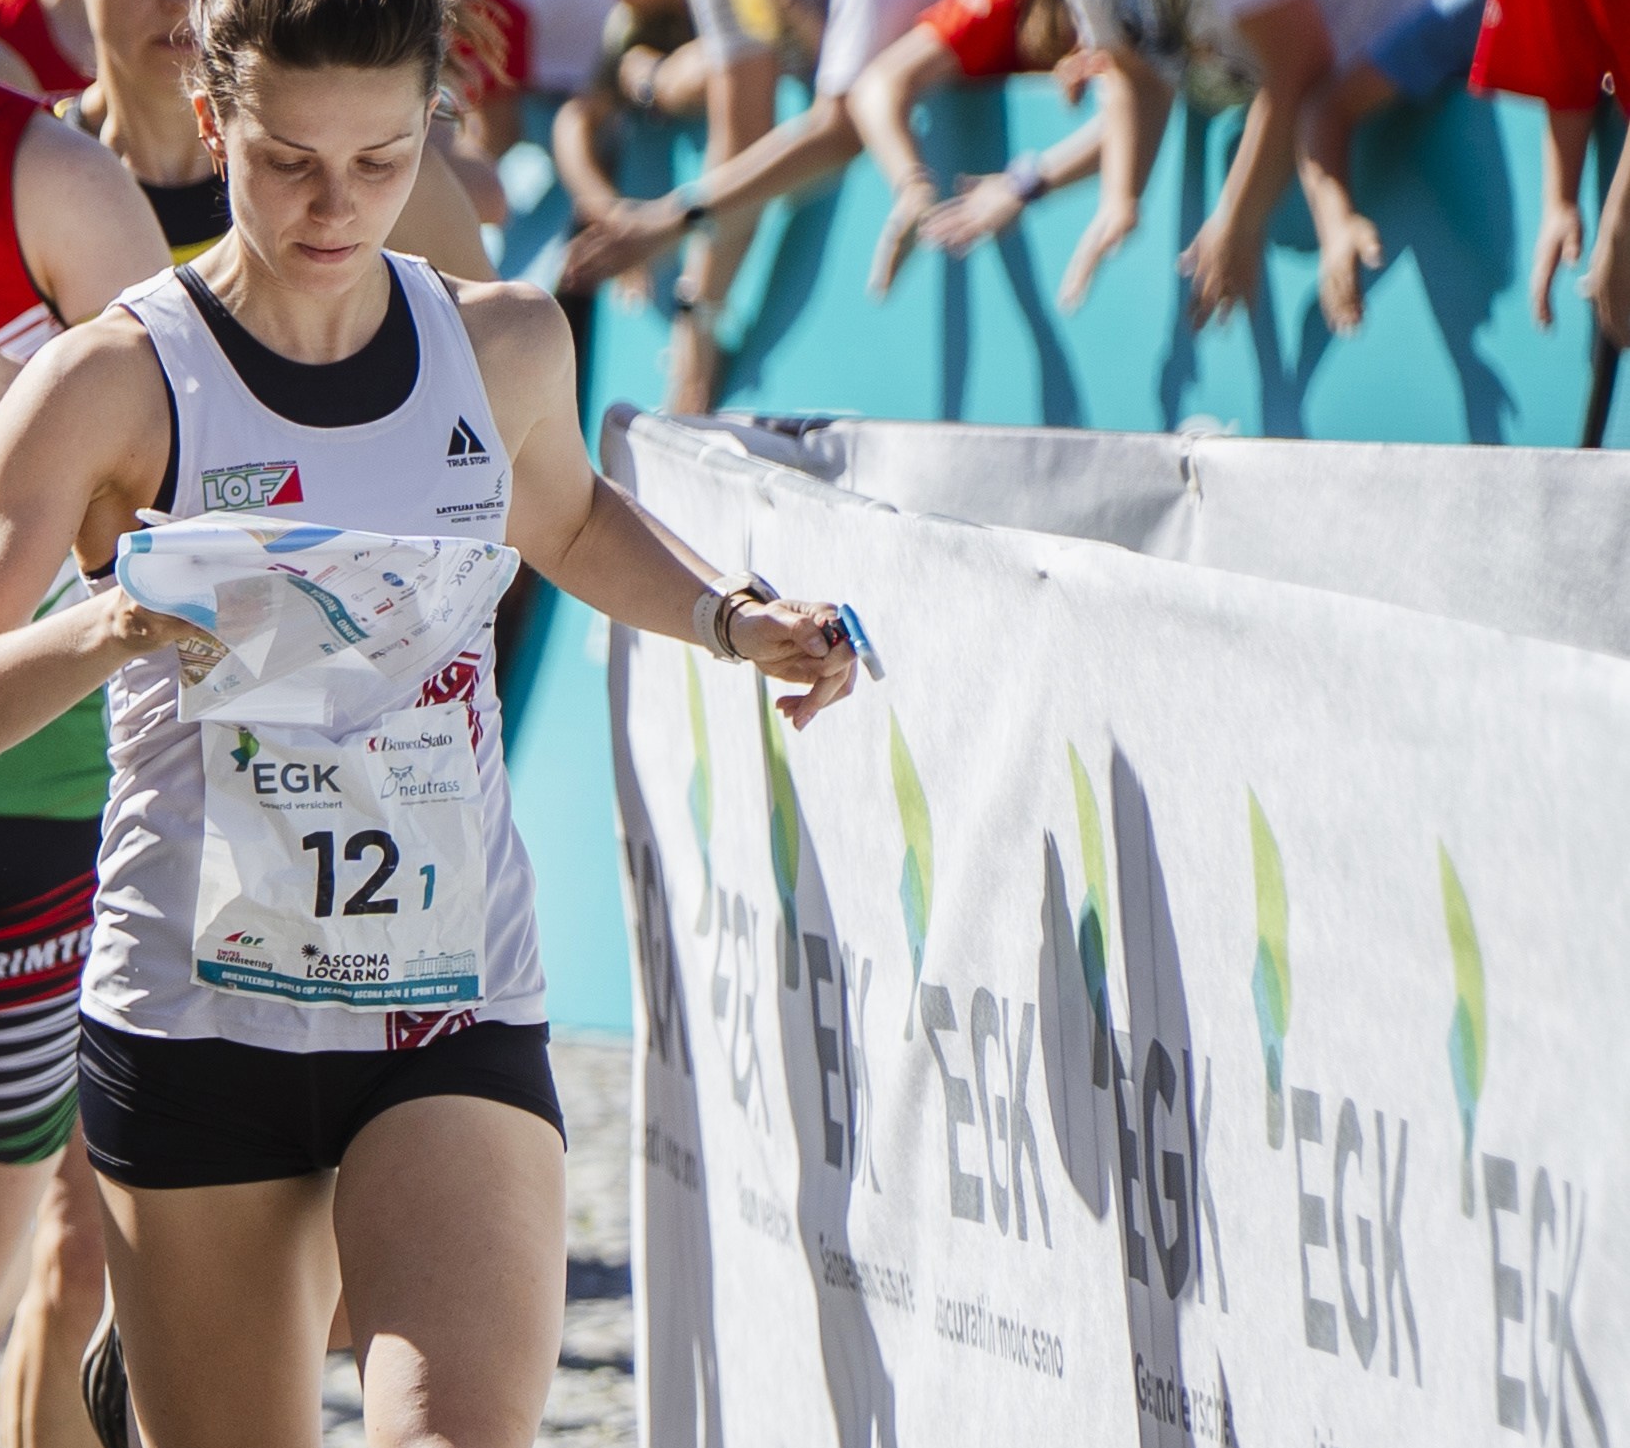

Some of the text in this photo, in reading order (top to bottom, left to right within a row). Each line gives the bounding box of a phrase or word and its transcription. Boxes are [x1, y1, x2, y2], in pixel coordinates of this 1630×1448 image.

[446, 455, 491, 468] TRUE STORY
[203, 471, 284, 511] LOF
[449, 548, 484, 587] EGK
[381, 732, 453, 752] BancaStato
[252, 762, 342, 795] EGK
[399, 779, 460, 797] neutrass
[295, 800, 343, 811] versichert
[302, 829, 436, 918] 12 1
[318, 953, 390, 968] ASCONA
[306, 966, 390, 982] LOCARNO
[353, 989, 383, 999] ASCONA
[411, 985, 435, 997] SPRINT
[435, 983, 459, 995] RELAY
[919, 981, 1054, 1250] EGK
[1112, 1026, 1230, 1315] EGK
[1290, 1085, 1423, 1388] EGK
